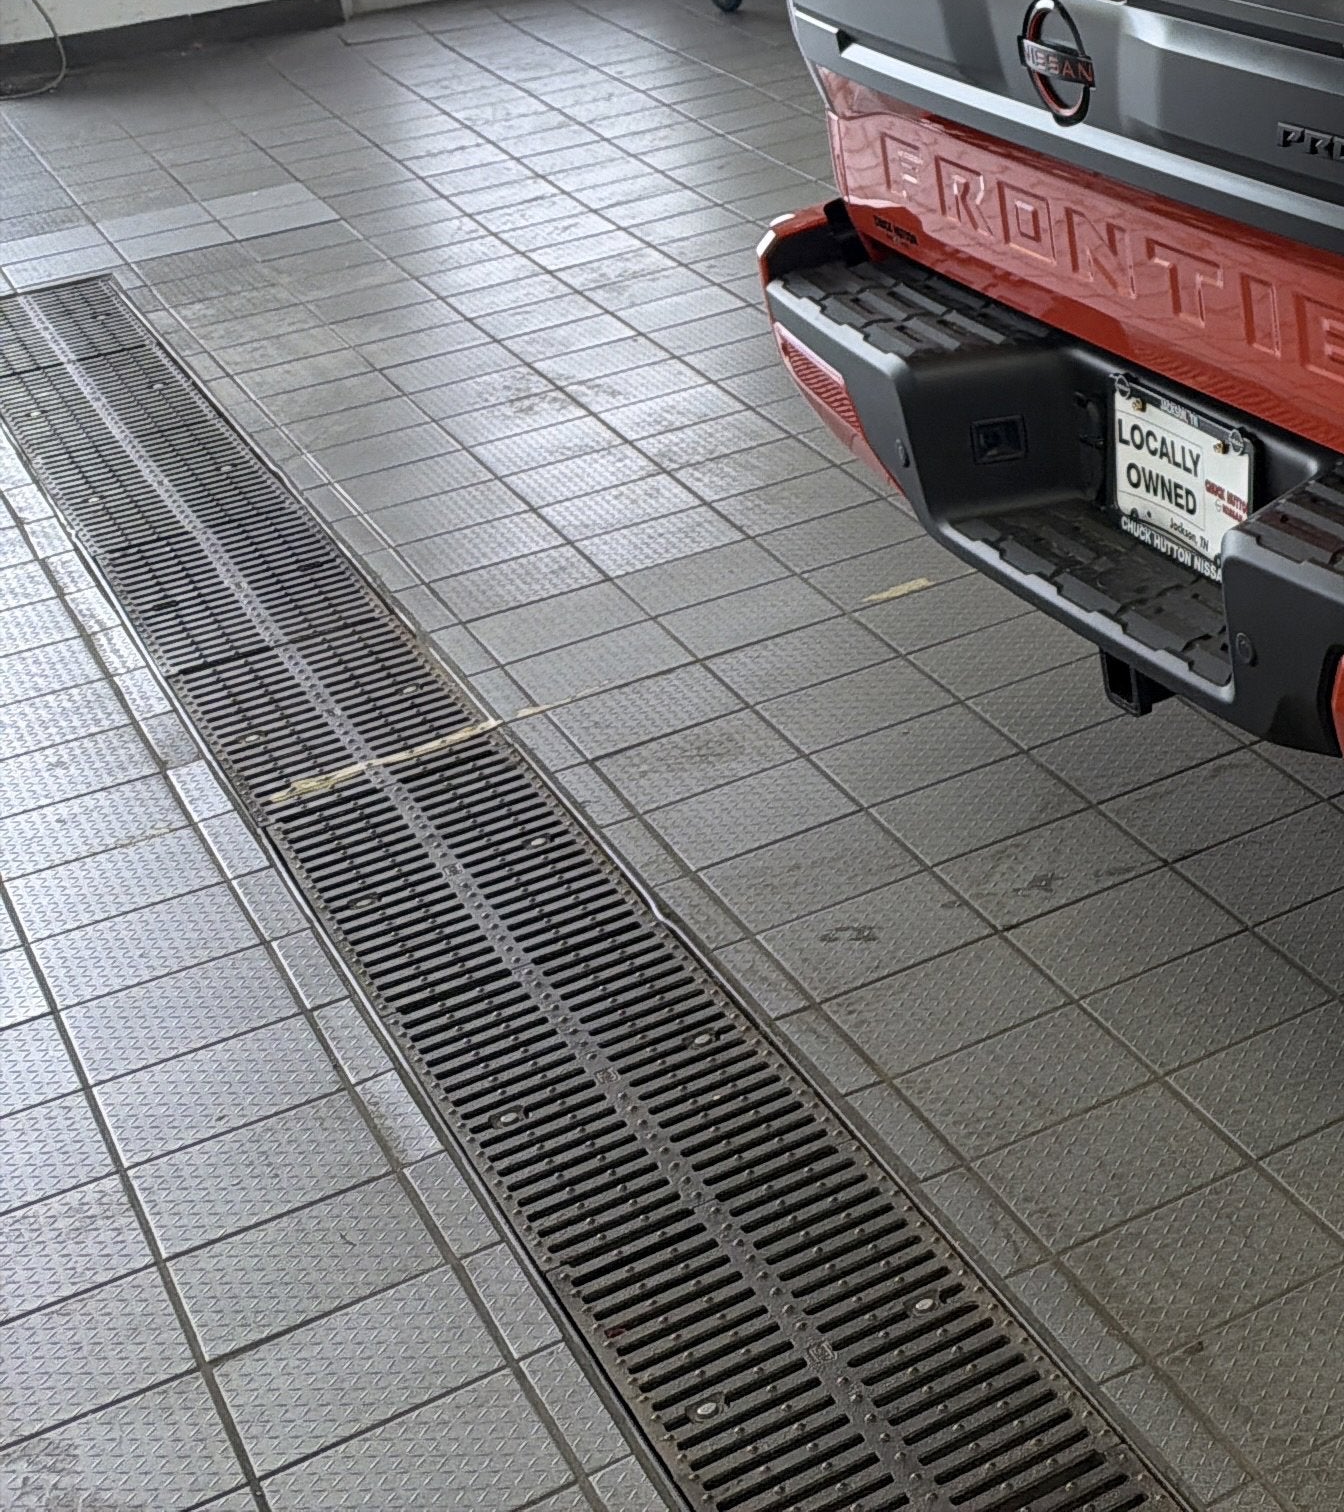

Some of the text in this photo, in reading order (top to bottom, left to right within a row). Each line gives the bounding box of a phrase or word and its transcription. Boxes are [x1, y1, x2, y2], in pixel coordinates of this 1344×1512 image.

[1024, 40, 1094, 83] NISSAN
[1117, 418, 1201, 478] LOCALLY
[1126, 462, 1197, 516] OWNED
[1226, 490, 1248, 514] HUTTO
[1121, 516, 1222, 582] CHUCK HUTTON NISSA
[1168, 517, 1209, 552] Jackson, TN
